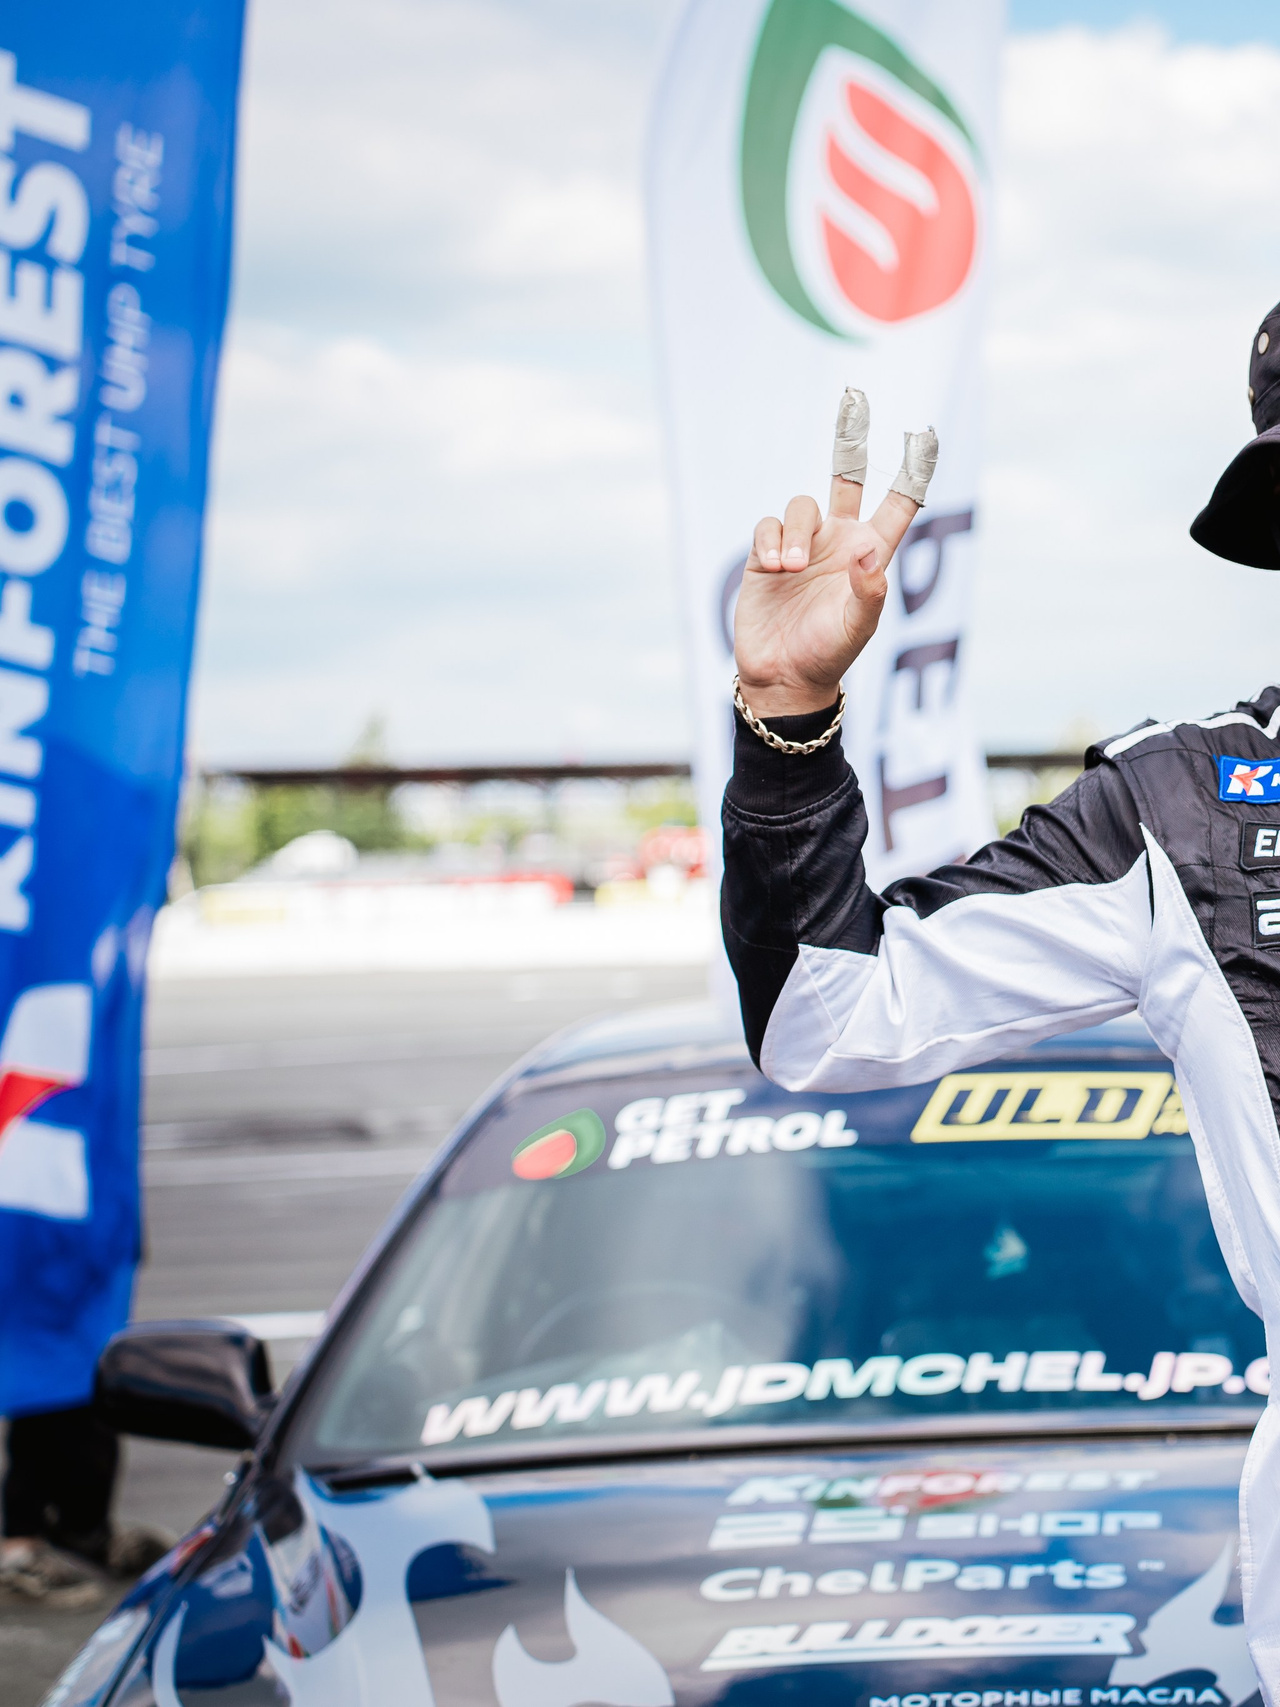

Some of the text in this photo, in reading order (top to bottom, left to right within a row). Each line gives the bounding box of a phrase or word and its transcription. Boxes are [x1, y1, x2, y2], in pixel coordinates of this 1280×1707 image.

[110, 120, 164, 272] TYRE
[85, 410, 142, 567] BEST
[74, 569, 127, 678] THE
[615, 1088, 747, 1135] GET
[607, 1109, 858, 1170] PETROL
[916, 1510, 1163, 1540] SHOP
[700, 1558, 1127, 1601] ChelParts
[707, 1613, 1136, 1660] BULLDOZER
[869, 1686, 1223, 1707] МОТОРНЫЕ МАСЛА
